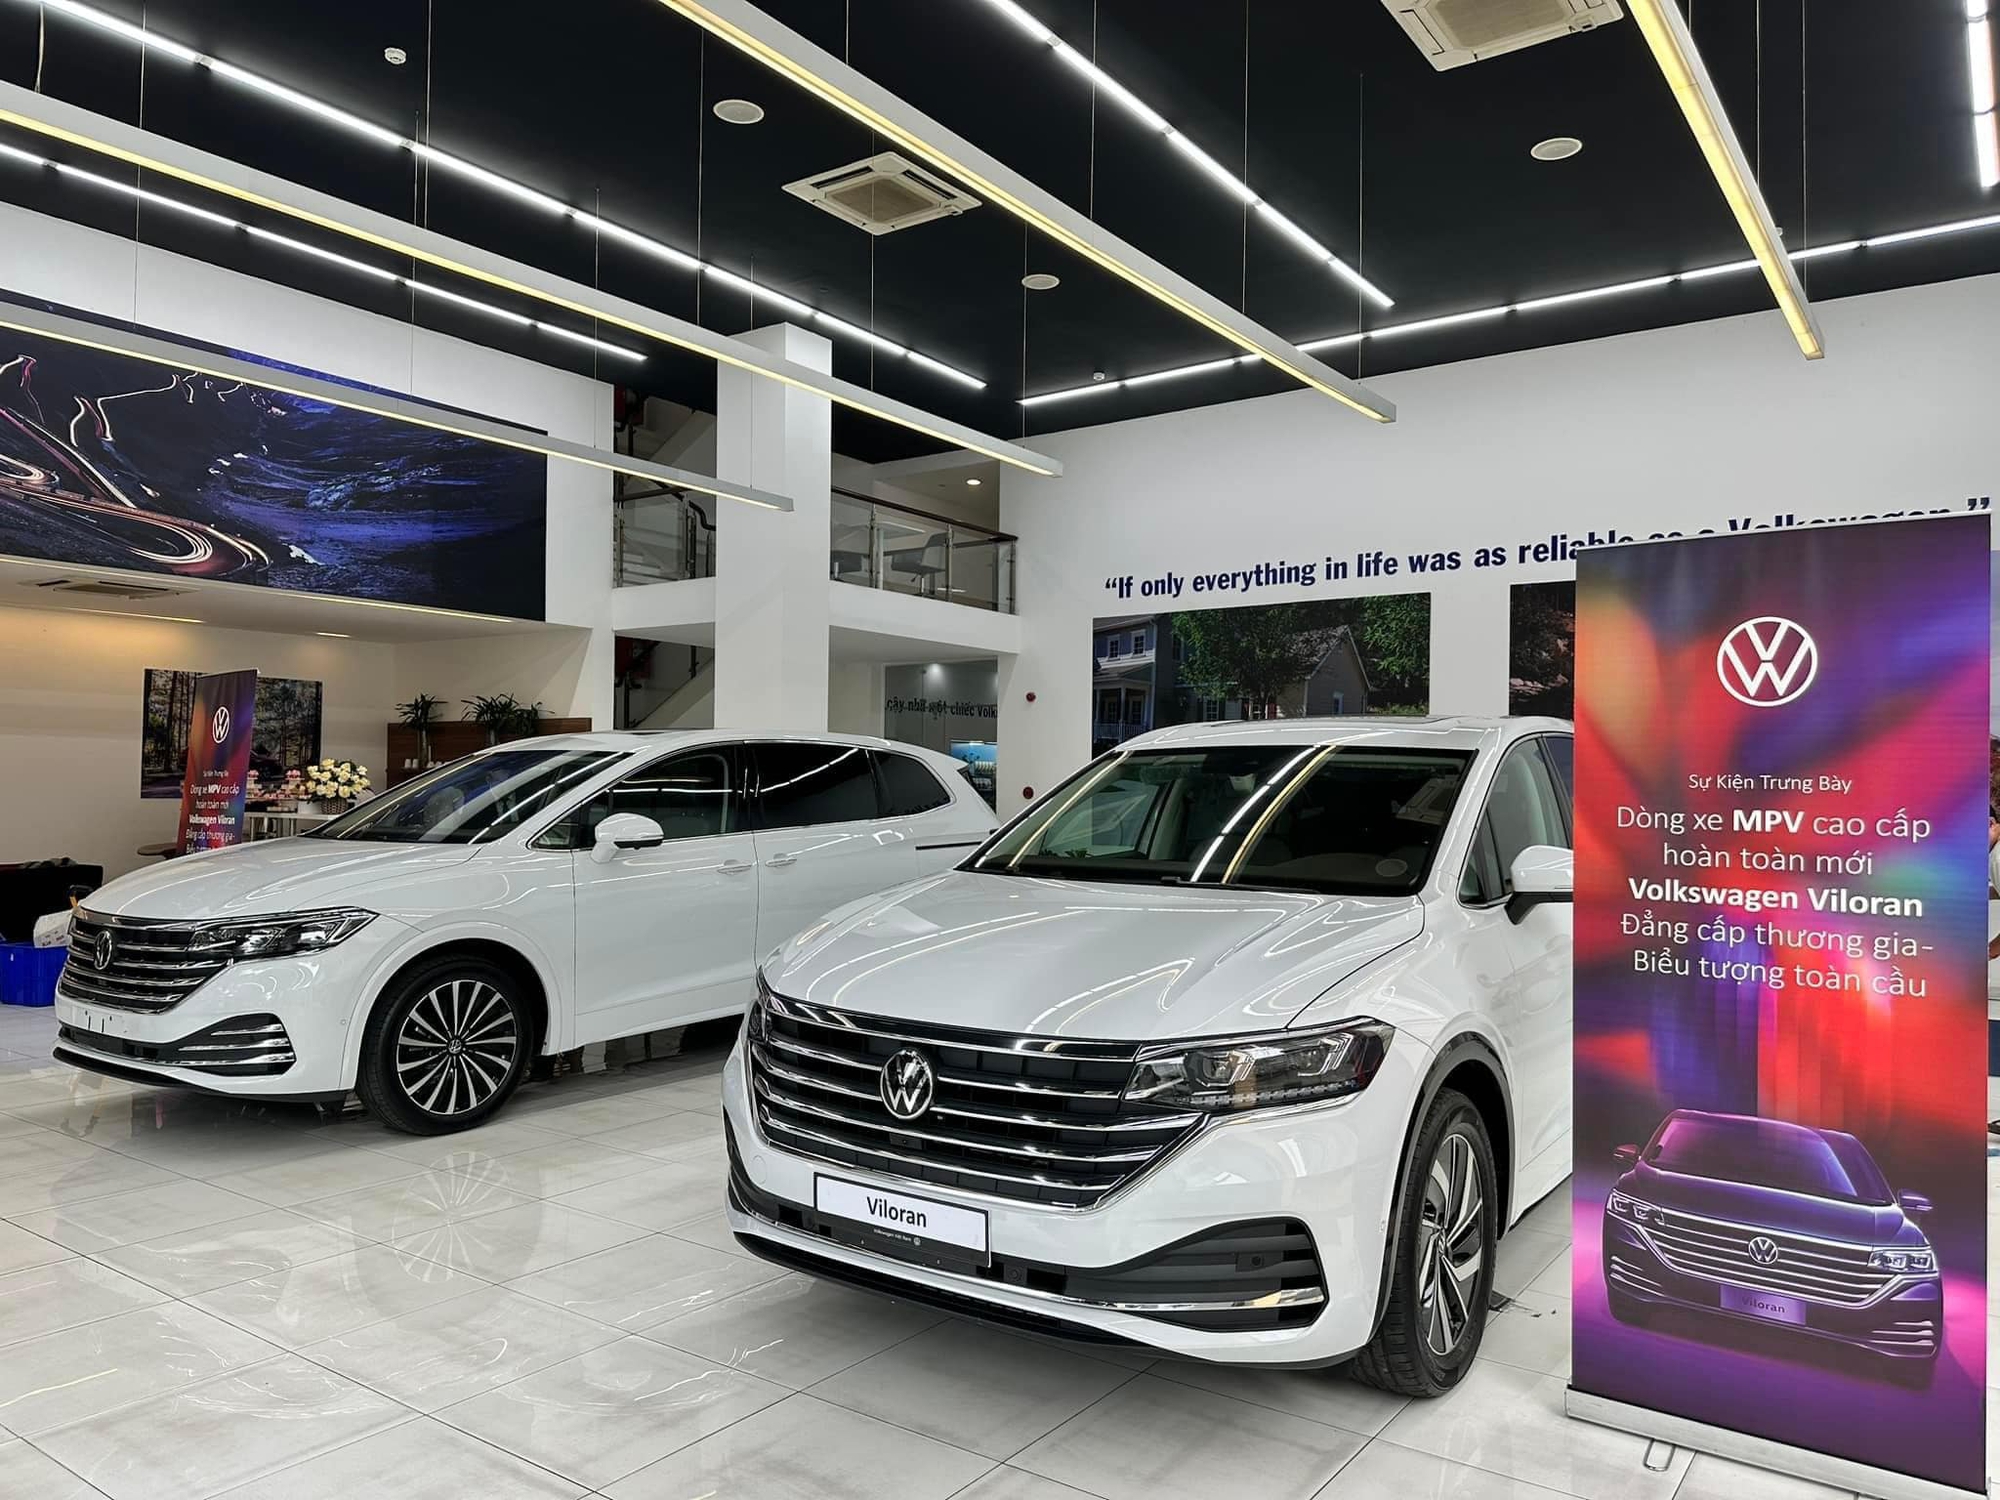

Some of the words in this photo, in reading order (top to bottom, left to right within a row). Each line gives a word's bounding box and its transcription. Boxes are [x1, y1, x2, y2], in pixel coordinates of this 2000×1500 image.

[1105, 575, 1133, 599] “If
[1141, 572, 1184, 598] only
[1192, 561, 1317, 592] everything
[1326, 557, 1347, 580] in
[1357, 552, 1398, 578] life
[1408, 551, 1461, 574] was
[1474, 546, 1506, 568] as
[977, 704, 998, 719] Volk
[1689, 774, 1711, 791] Sự
[1717, 774, 1753, 792] Kiện
[1760, 775, 1813, 794] Trưng
[1819, 775, 1852, 795] Bày
[1617, 806, 1685, 834] Dòng
[1693, 813, 1723, 831] xe
[1733, 809, 1805, 833] MPV
[1813, 816, 1865, 835] cao
[1876, 808, 1930, 843] cấp
[1664, 842, 1730, 868] hoàn
[1740, 846, 1804, 872] toàn
[1816, 850, 1873, 875] mới
[1628, 878, 1798, 912] Volkswagen
[1807, 888, 1923, 917] Viloran
[1621, 909, 1688, 944] Đẳng
[1697, 915, 1745, 948] cấp
[1755, 922, 1864, 958] thương
[1874, 932, 1933, 960] gia-
[1634, 947, 1689, 975] Biểu
[1699, 957, 1785, 989] tượng
[1794, 965, 1860, 992] toàn
[1872, 966, 1926, 997] cầu
[867, 1196, 927, 1228] Viloran
[1742, 1297, 1786, 1313] Viloran
